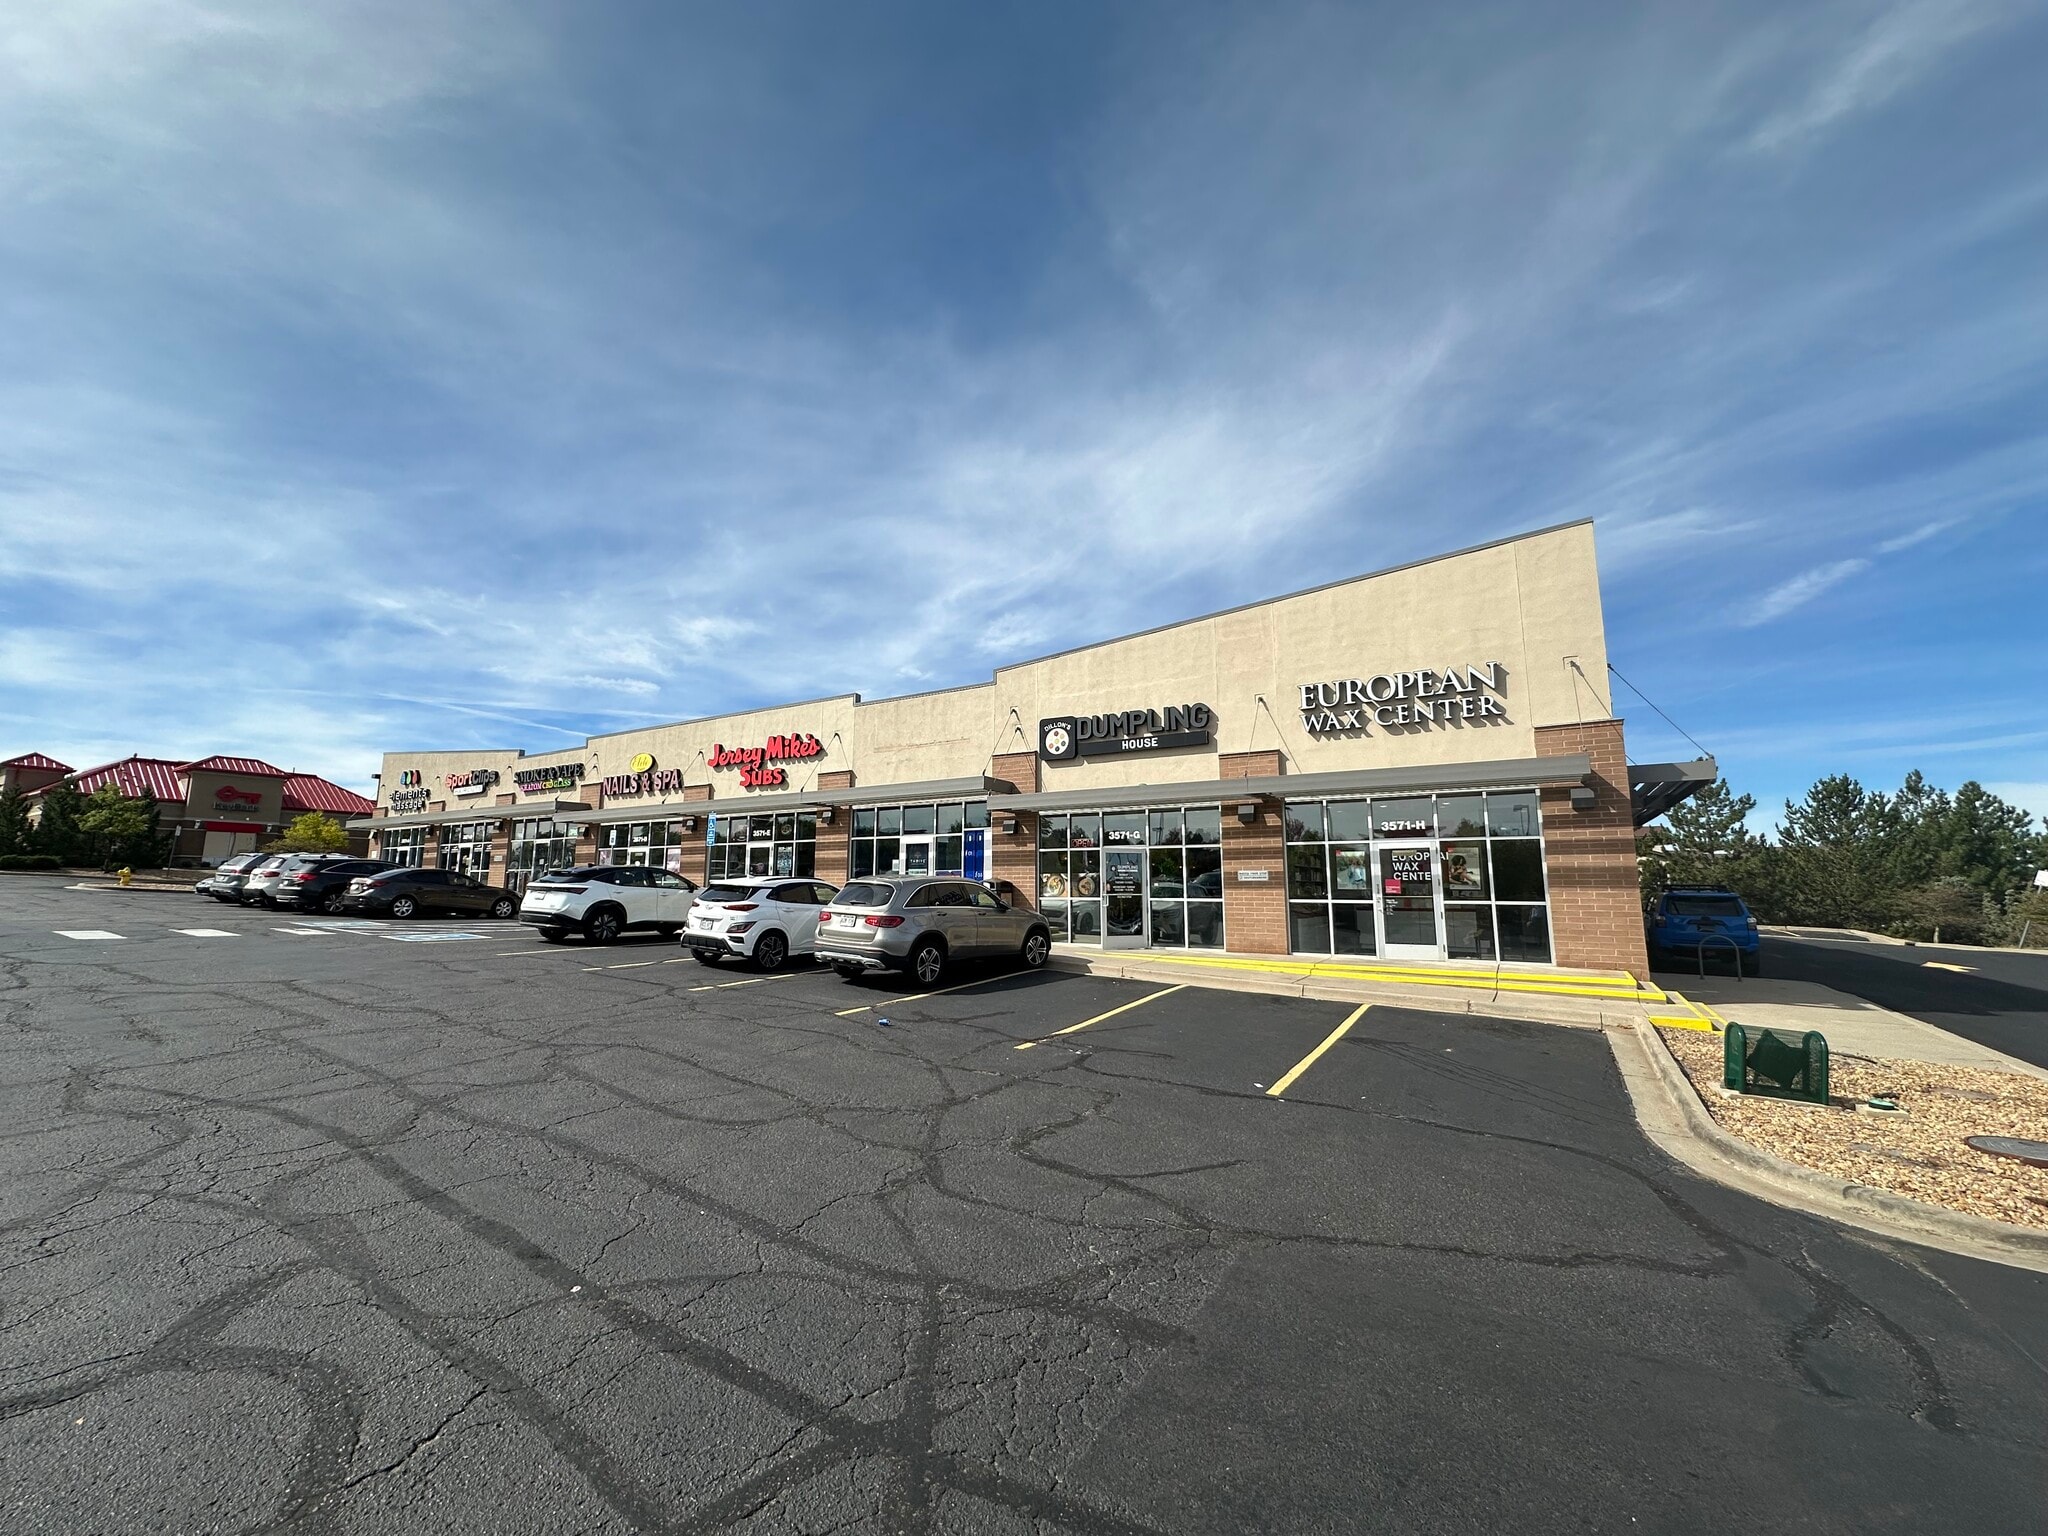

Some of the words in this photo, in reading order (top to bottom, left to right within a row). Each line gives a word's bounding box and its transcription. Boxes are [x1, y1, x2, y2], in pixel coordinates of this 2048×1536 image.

[1299, 661, 1498, 711] EUROPEAN
[1301, 709, 1363, 732] WAX
[1374, 695, 1502, 726] CENTER
[1044, 721, 1072, 732] DILLON'S
[1076, 702, 1209, 740] DUMPLING
[1121, 737, 1159, 750] HOUSE
[708, 743, 762, 769] Jersey
[765, 732, 821, 760] Mike's
[514, 768, 546, 783] SMOKE
[547, 766, 554, 779] &
[555, 763, 581, 777] VAPE
[602, 774, 638, 796] NAILS
[642, 773, 651, 791] &
[654, 769, 680, 789] SPA
[1380, 820, 1427, 831] 3571-H
[752, 829, 771, 837] 3571-E
[1108, 830, 1141, 840] 3571-G
[1392, 862, 1420, 871] WAX
[1393, 872, 1432, 881] CENTE
